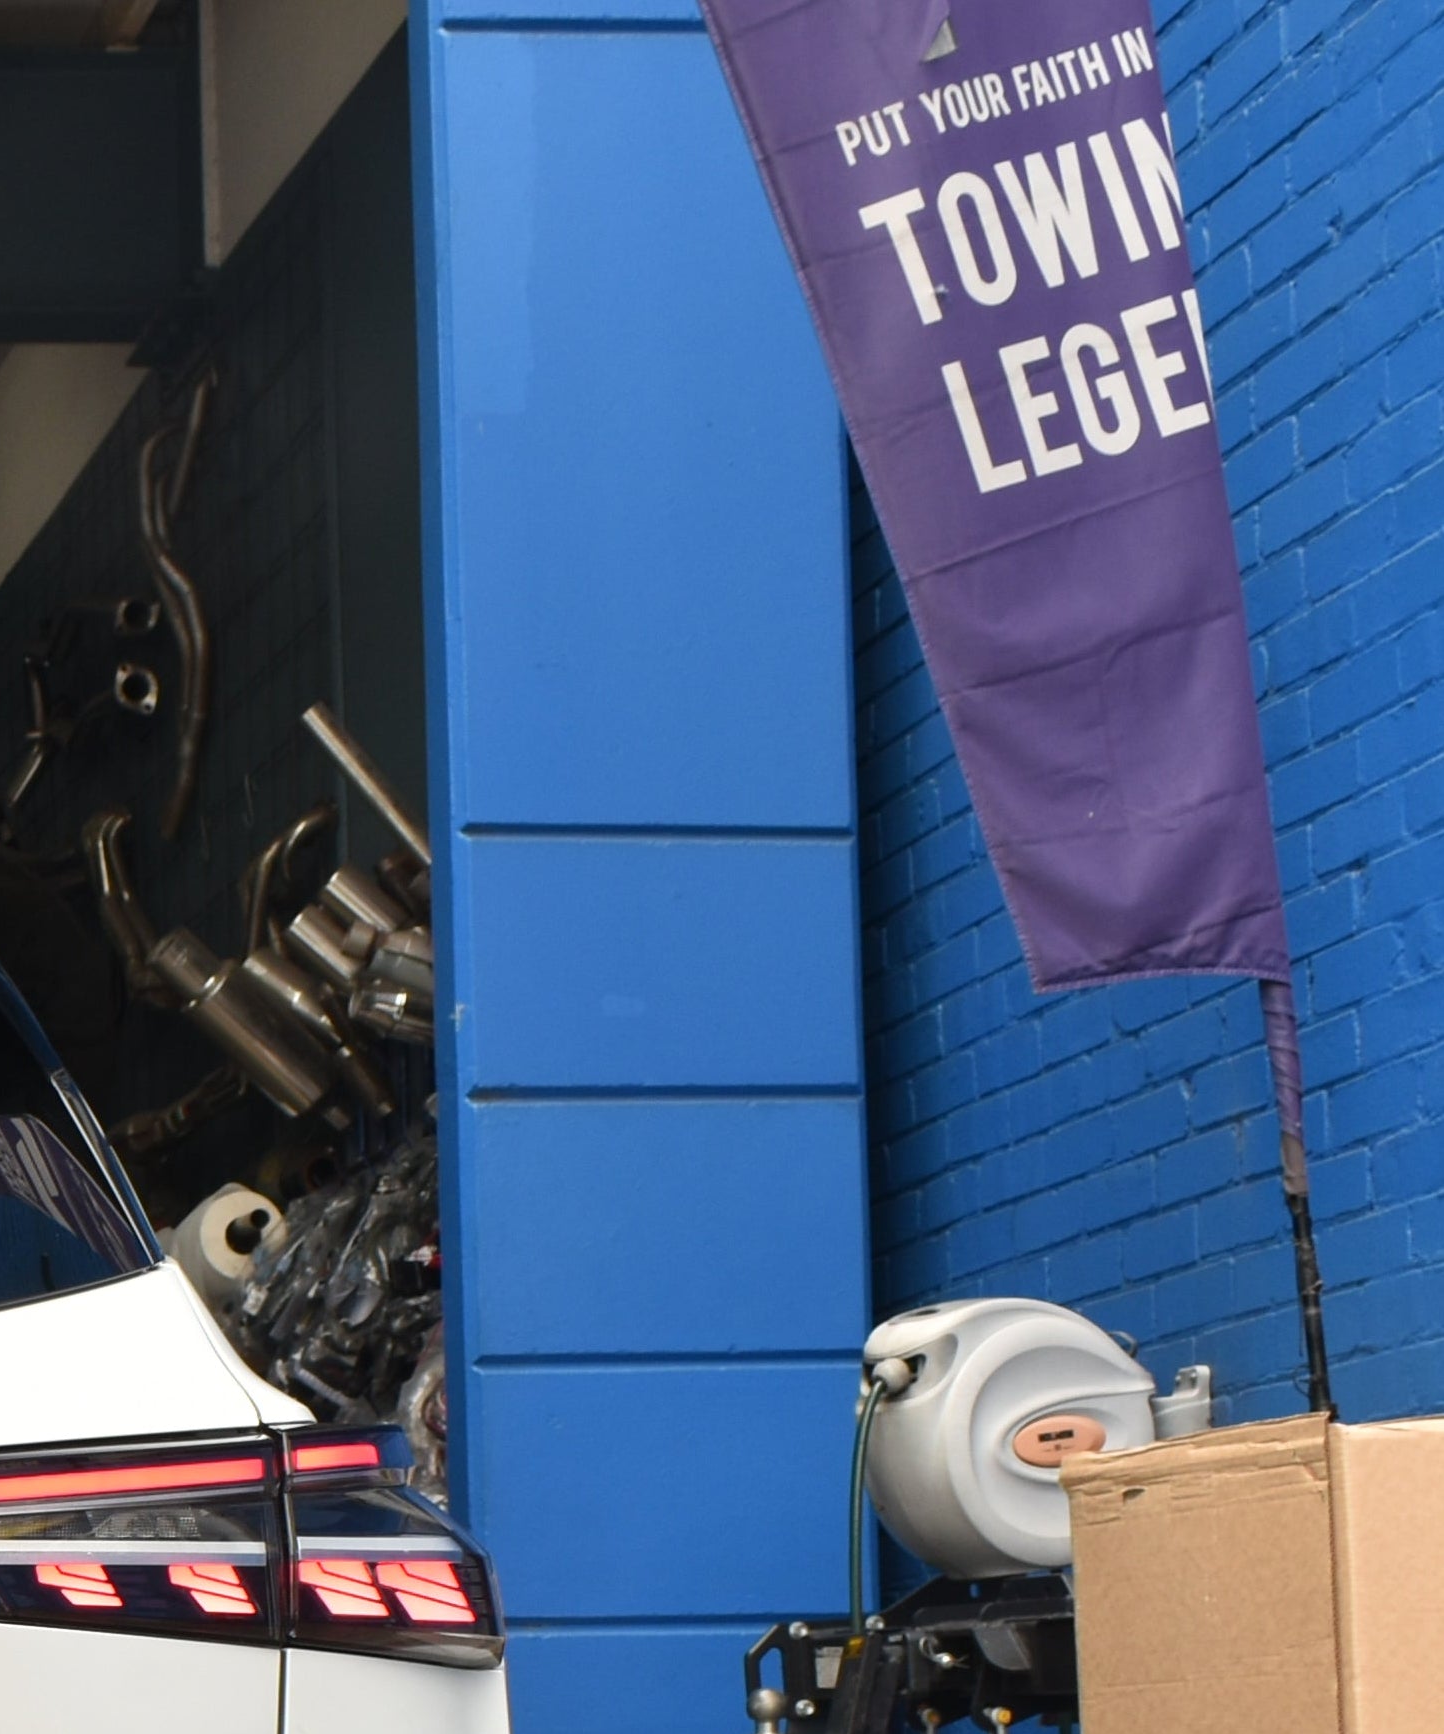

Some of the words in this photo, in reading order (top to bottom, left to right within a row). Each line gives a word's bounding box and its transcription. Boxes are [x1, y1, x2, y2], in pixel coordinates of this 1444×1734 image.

[836, 103, 912, 166] PUT
[918, 73, 1011, 136] YOUR
[1012, 43, 1110, 109] FAITH
[1112, 27, 1154, 79] IN
